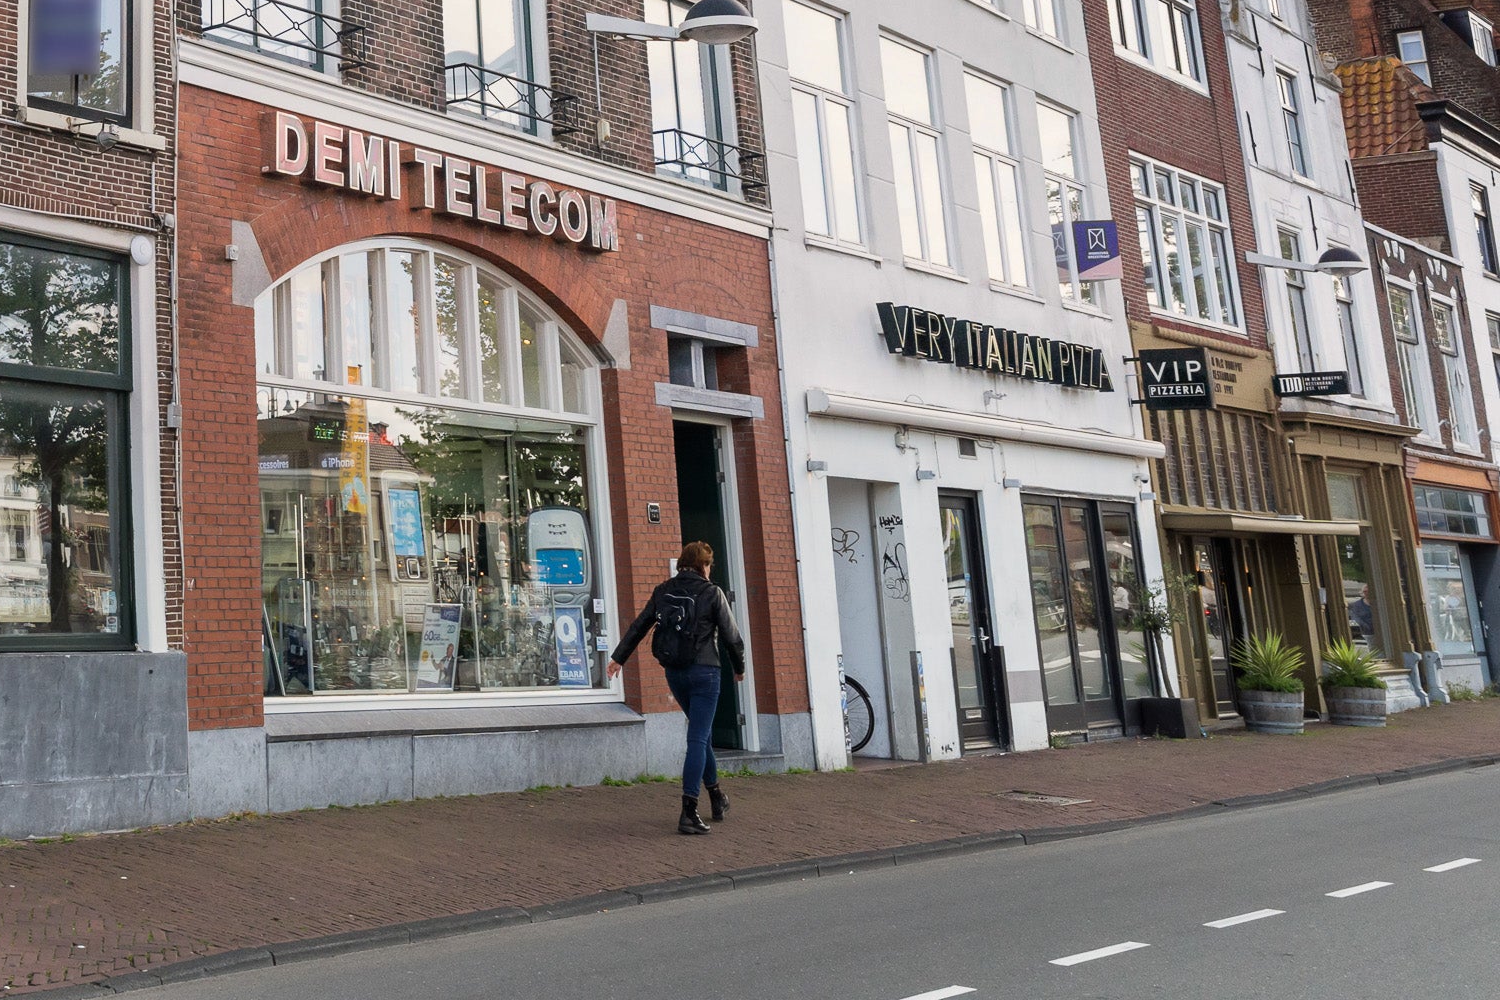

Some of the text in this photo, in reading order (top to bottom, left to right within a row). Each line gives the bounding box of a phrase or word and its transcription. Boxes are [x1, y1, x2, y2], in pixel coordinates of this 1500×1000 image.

[275, 111, 619, 251] DEMI TELECOM
[890, 304, 1114, 391] VERY ITALIAN PIZZA
[1146, 360, 1201, 382] VIP
[1150, 385, 1204, 395] PIZZERIA
[1279, 377, 1303, 393] IDD
[258, 460, 289, 469] cessoires
[328, 458, 355, 468] iPhone
[560, 671, 584, 679] EBARA
